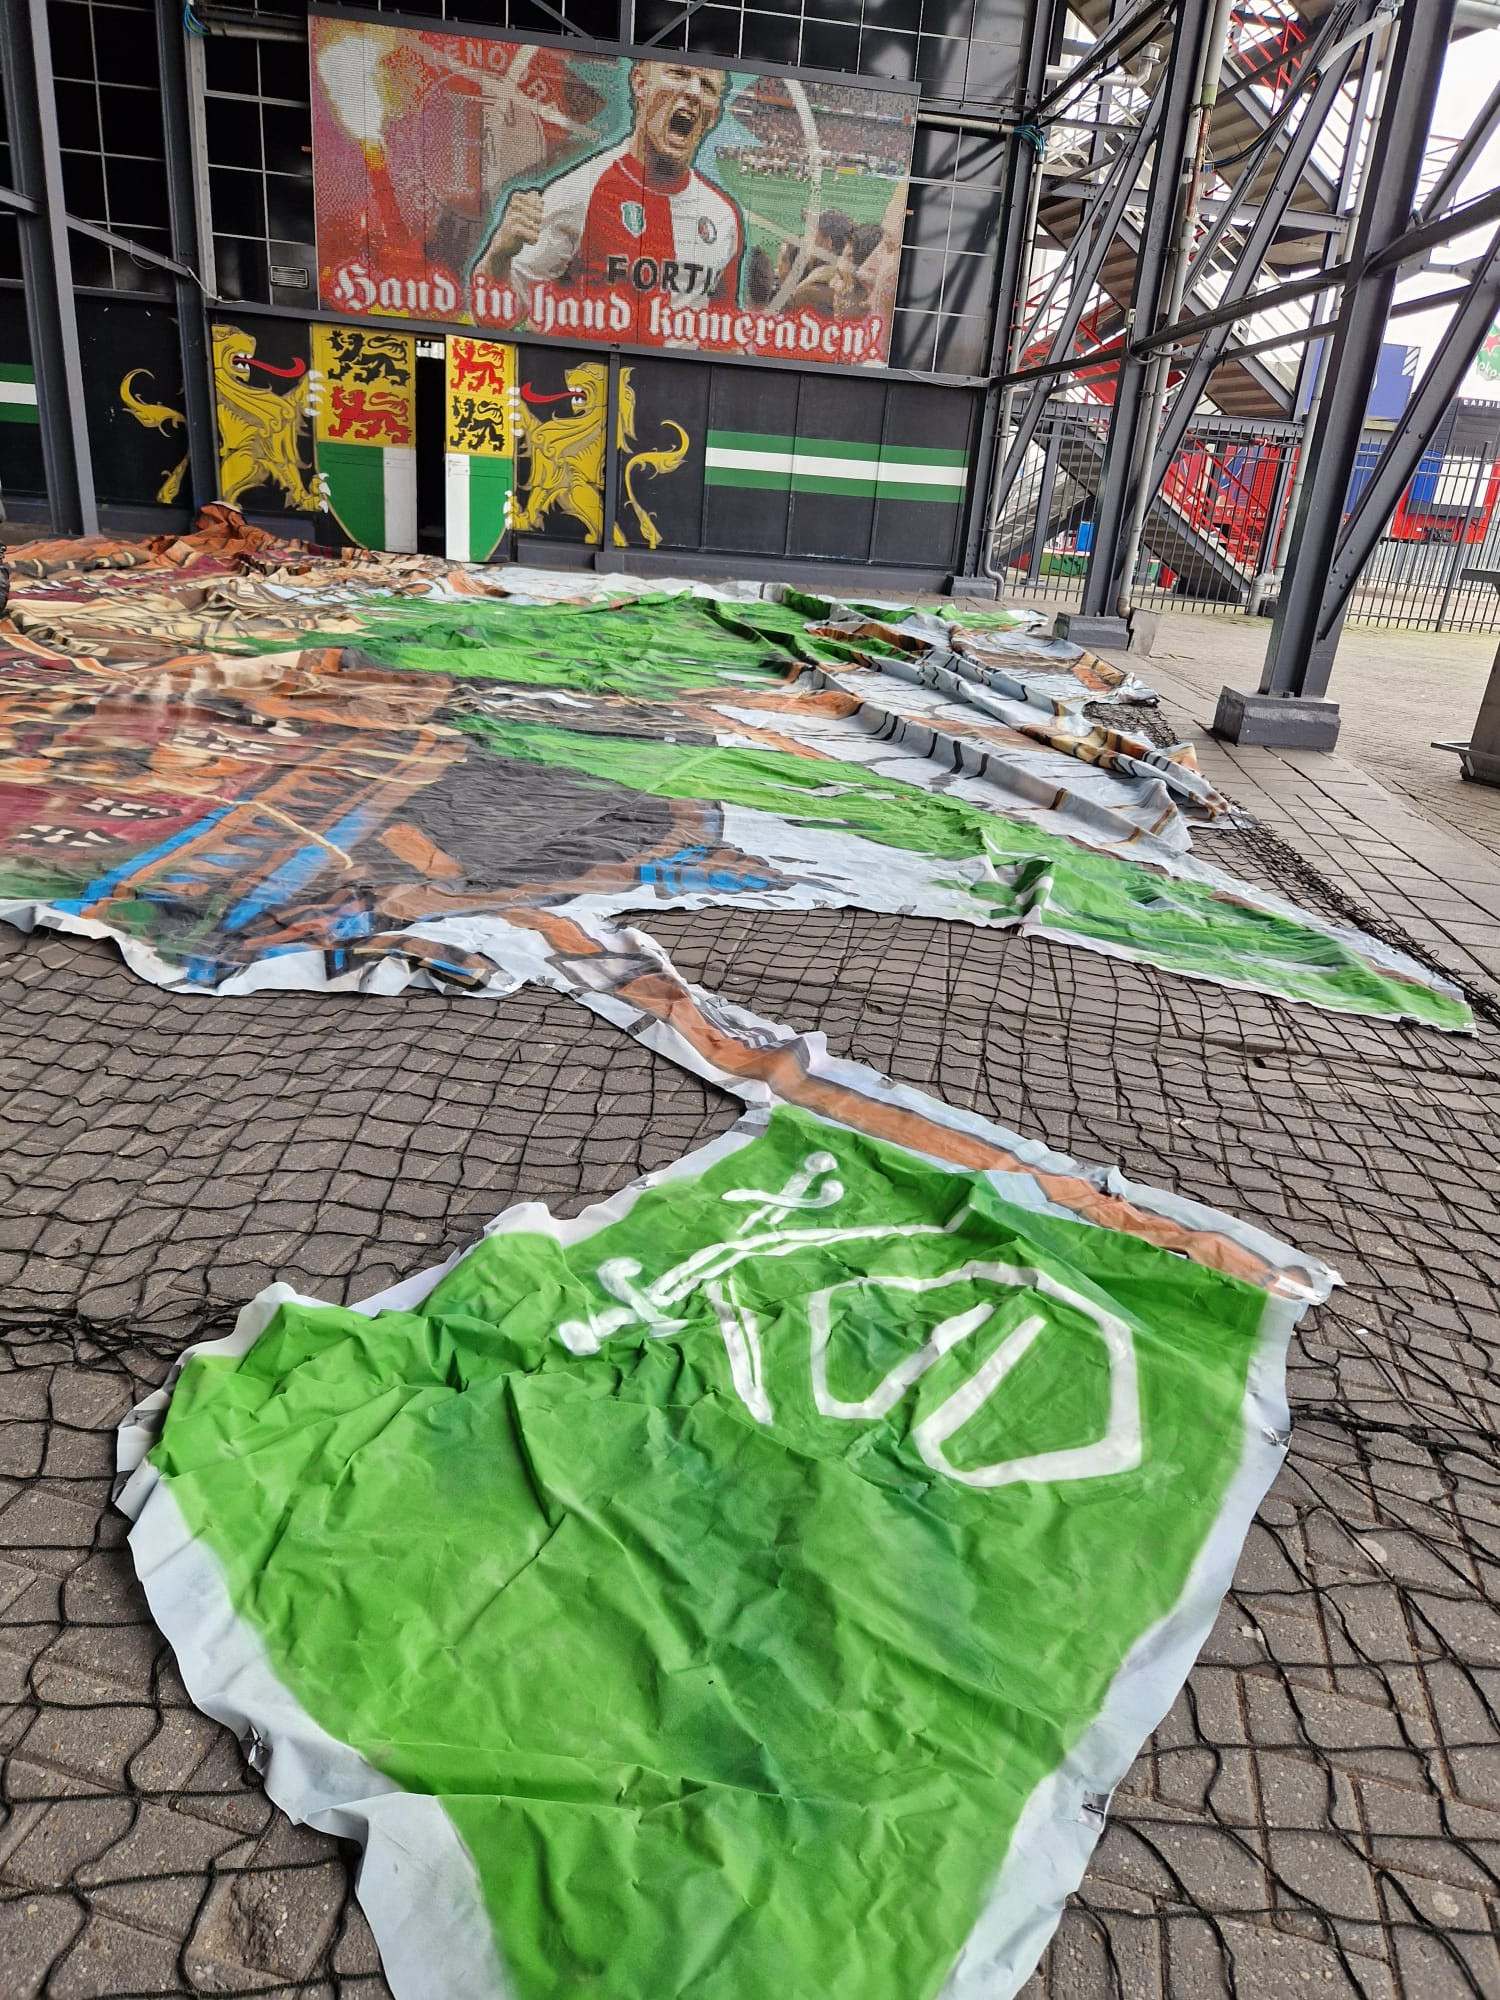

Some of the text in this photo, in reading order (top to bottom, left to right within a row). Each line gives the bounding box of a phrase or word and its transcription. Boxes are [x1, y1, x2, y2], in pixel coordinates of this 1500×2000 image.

[334, 263, 879, 357] Hand in hand kameraden!
